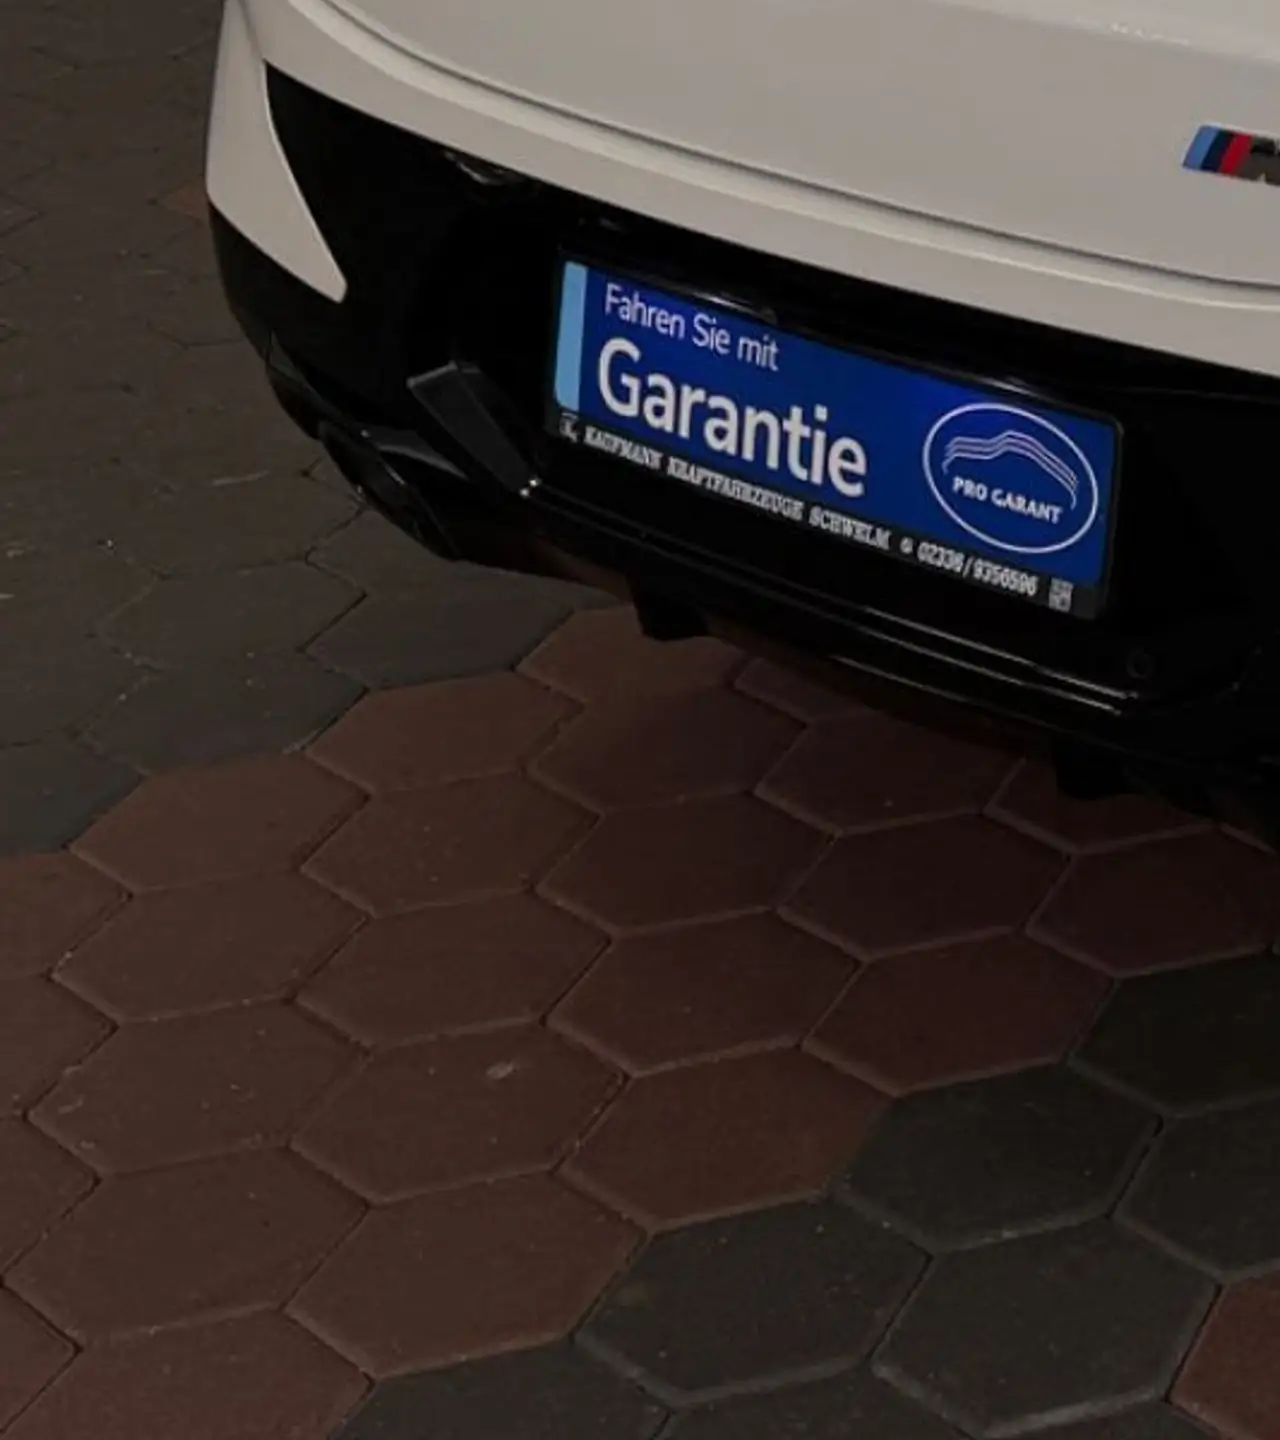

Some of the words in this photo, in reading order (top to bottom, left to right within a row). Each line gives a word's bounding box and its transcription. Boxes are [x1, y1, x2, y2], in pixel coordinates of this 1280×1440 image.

[604, 282, 685, 340] Fahren
[692, 312, 731, 355] Sie
[737, 334, 780, 372] mit
[597, 337, 868, 498] Garantie
[583, 424, 663, 470] KAUFMANN
[808, 506, 892, 550] SCHWELM
[951, 475, 988, 502] PRO
[991, 488, 1063, 525] GARANT
